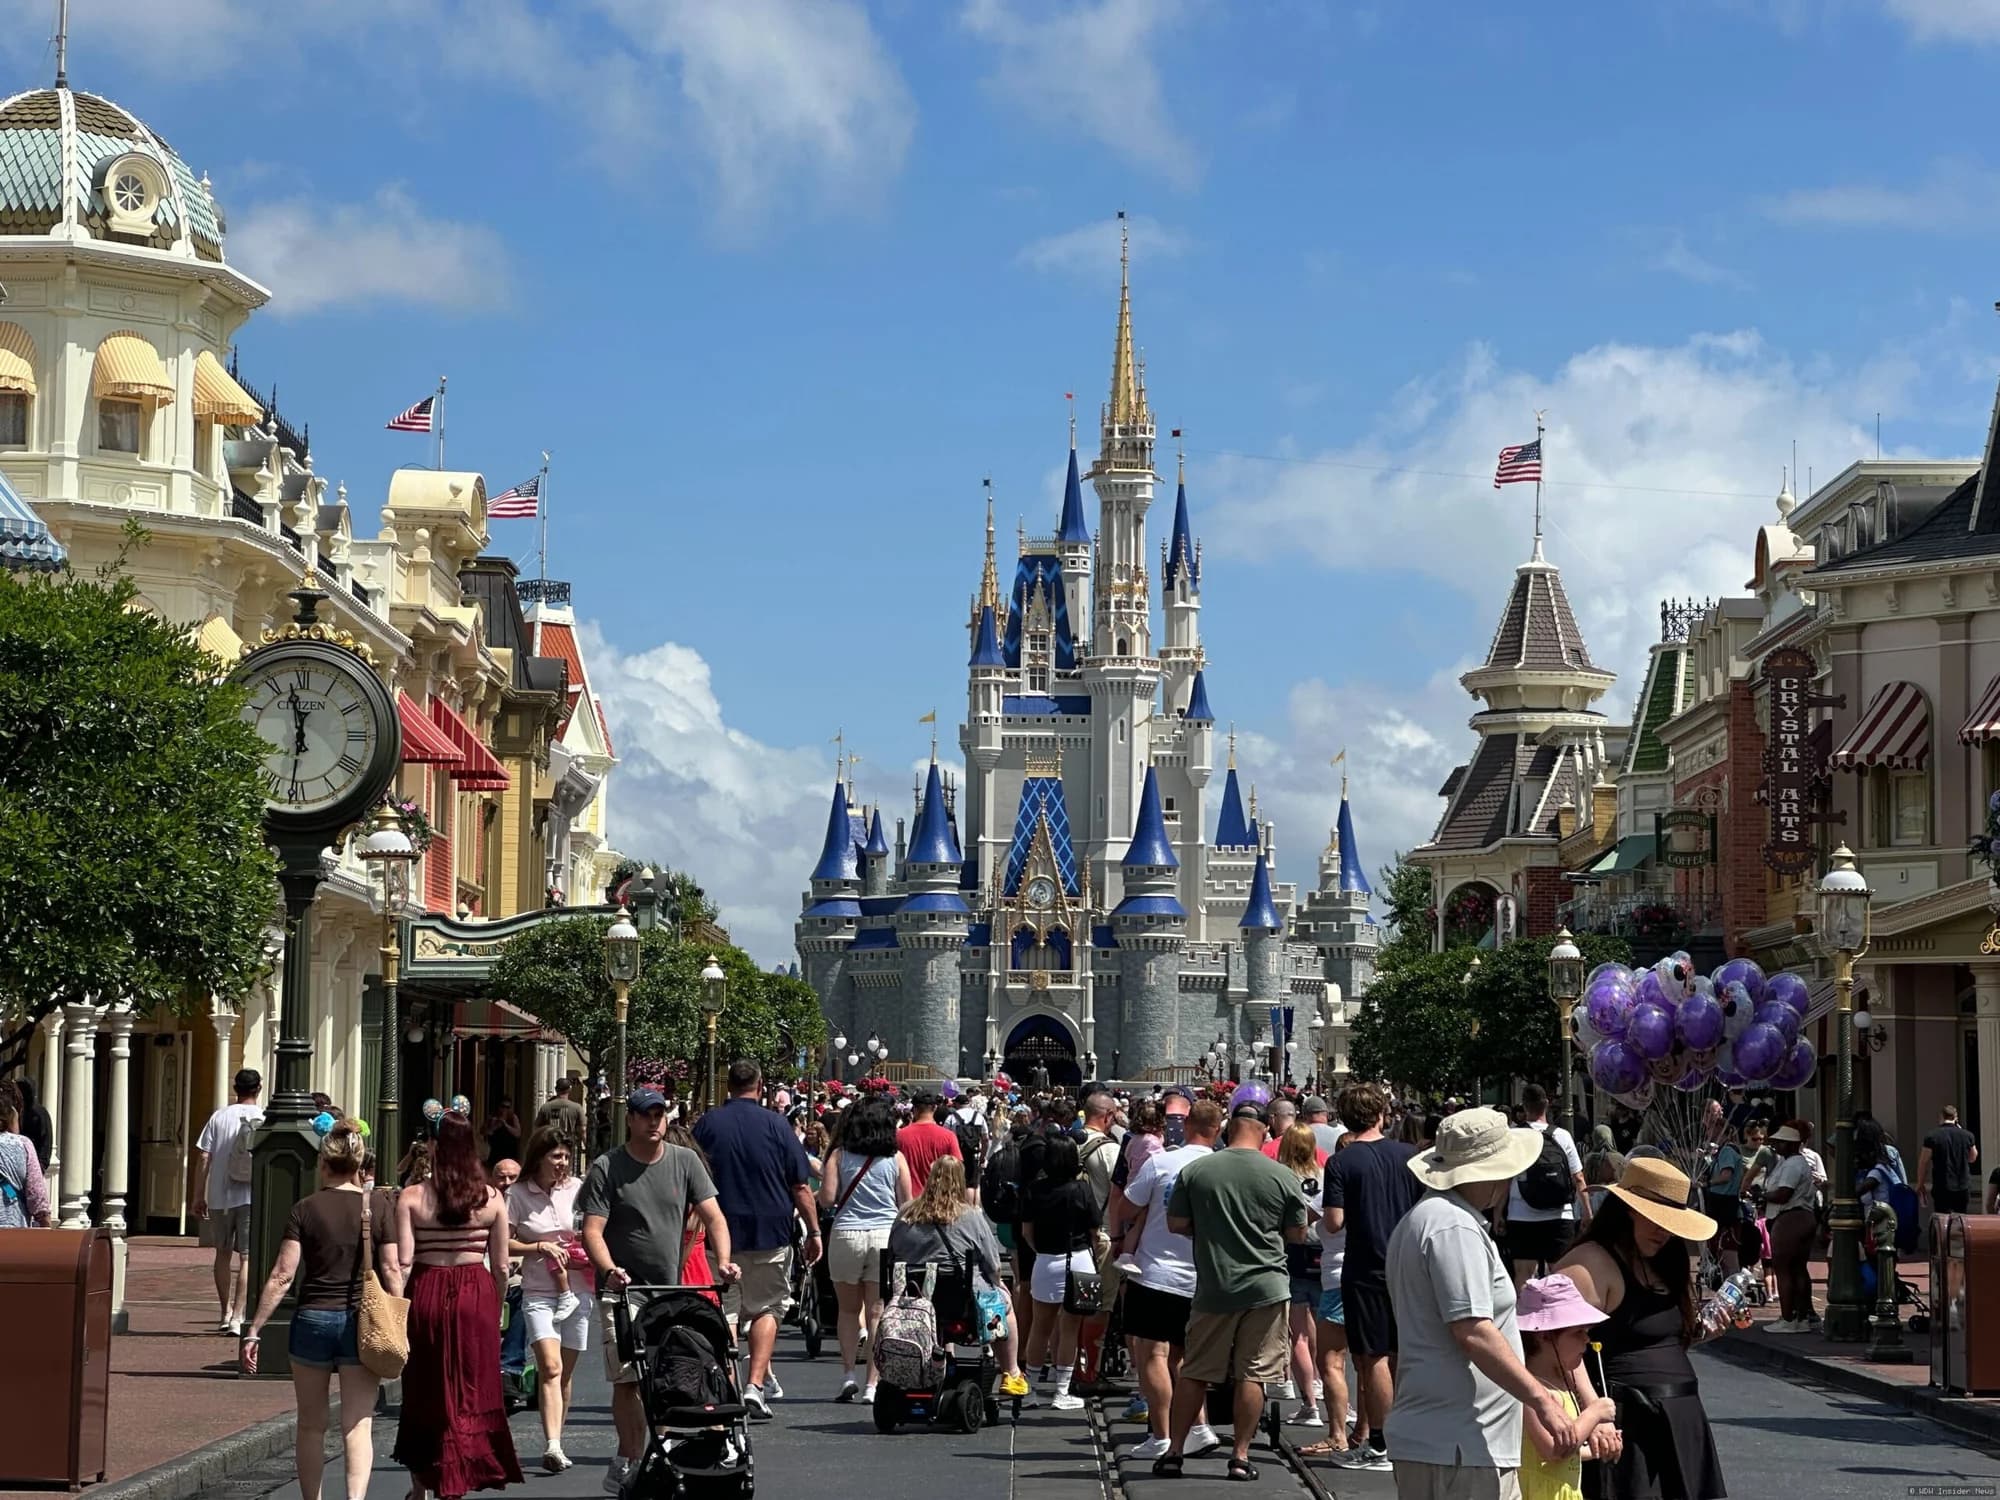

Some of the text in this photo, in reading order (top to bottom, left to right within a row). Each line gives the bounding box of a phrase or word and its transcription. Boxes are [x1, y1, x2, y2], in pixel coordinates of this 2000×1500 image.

[1780, 677, 1800, 842] CRYSTAL ARTS
[1667, 852, 1705, 866] COFFEE
[467, 943, 493, 957] Main
